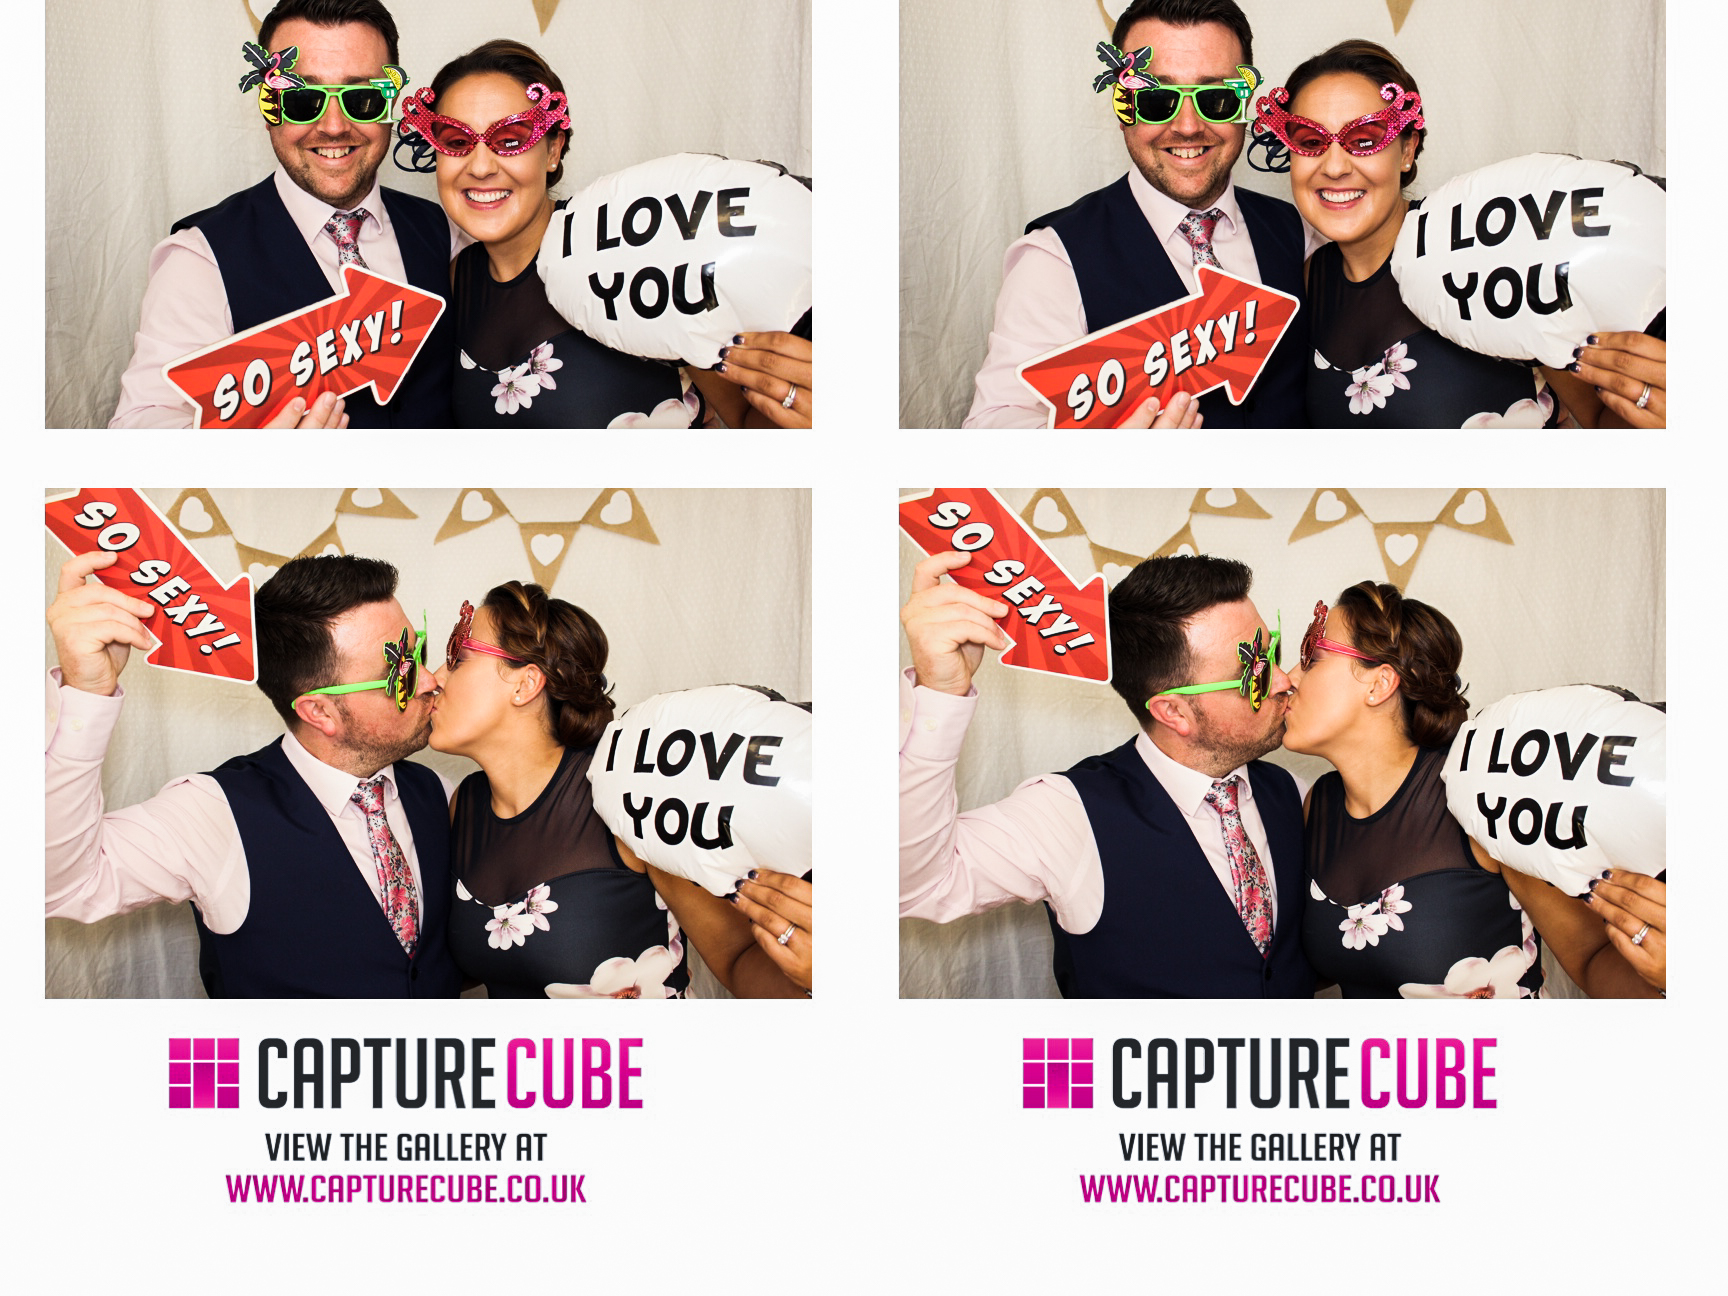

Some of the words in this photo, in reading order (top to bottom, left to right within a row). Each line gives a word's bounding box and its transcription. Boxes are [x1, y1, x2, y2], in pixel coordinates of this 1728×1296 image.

[562, 211, 575, 258] I
[596, 187, 758, 251] LOVE
[1416, 211, 1429, 258] I
[1450, 187, 1612, 251] LOVE
[588, 261, 720, 320] YOU
[1442, 261, 1574, 320] YOU
[213, 358, 272, 421] SO
[289, 299, 405, 387] SEXY!
[1067, 358, 1126, 421] SO
[1143, 299, 1259, 387] SEXY!
[74, 501, 141, 552] SO
[129, 559, 242, 656] SEXY!
[928, 501, 995, 552] SO
[983, 559, 1096, 656] SEXY!
[605, 728, 623, 772] I
[633, 728, 784, 787] LOVE
[1459, 728, 1477, 772] I
[1487, 728, 1638, 787] LOVE
[622, 792, 735, 850] YOU
[1476, 792, 1589, 850] YOU
